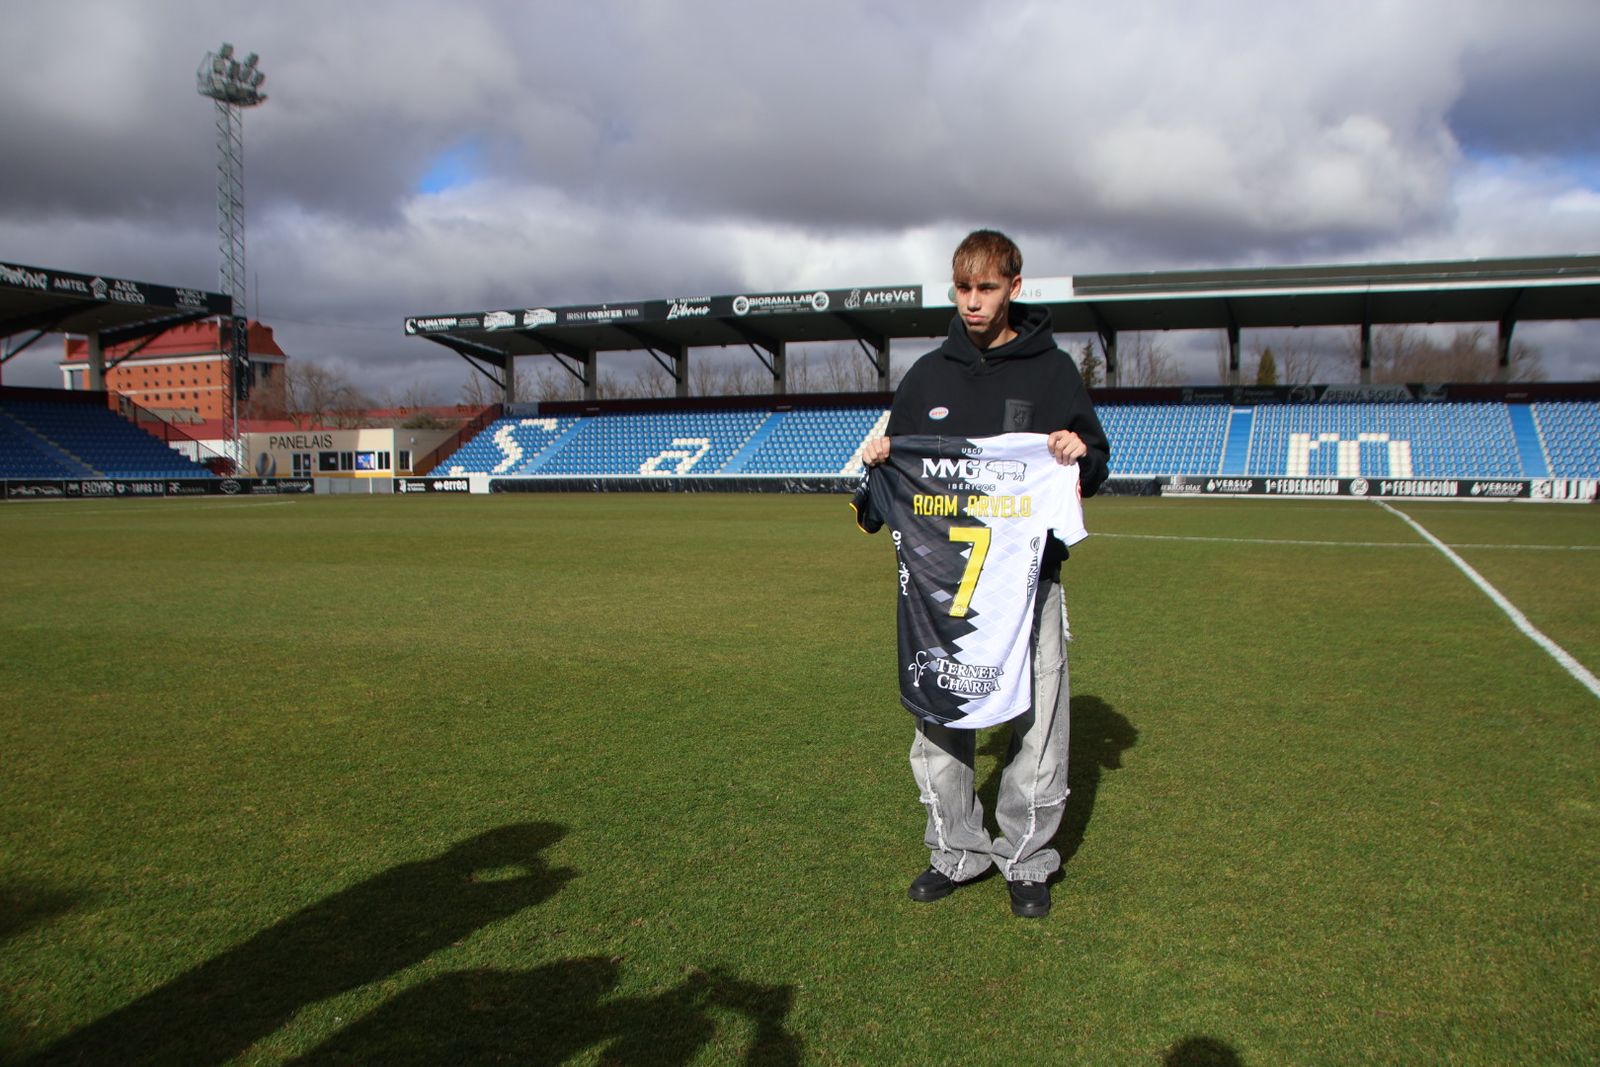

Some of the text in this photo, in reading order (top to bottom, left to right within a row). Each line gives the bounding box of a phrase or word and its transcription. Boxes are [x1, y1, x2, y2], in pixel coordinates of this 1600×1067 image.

[749, 294, 813, 306] BIORAMA LAB
[863, 289, 916, 304] ArteVet
[587, 309, 623, 320] CORNER
[269, 434, 333, 450] PANELAIS
[921, 458, 980, 480] MMG
[948, 482, 996, 491] IBÉRICOS
[1215, 479, 1253, 488] VERSUS
[1277, 477, 1339, 494] FEDERACIÓN
[1392, 478, 1458, 496] FEDERACIÓN
[1479, 481, 1524, 491] VERSUS
[913, 494, 1032, 518] ADAM ARVELO
[949, 526, 992, 618] 7
[936, 658, 1004, 681] TERNERA
[936, 674, 1001, 694] CHARRA
